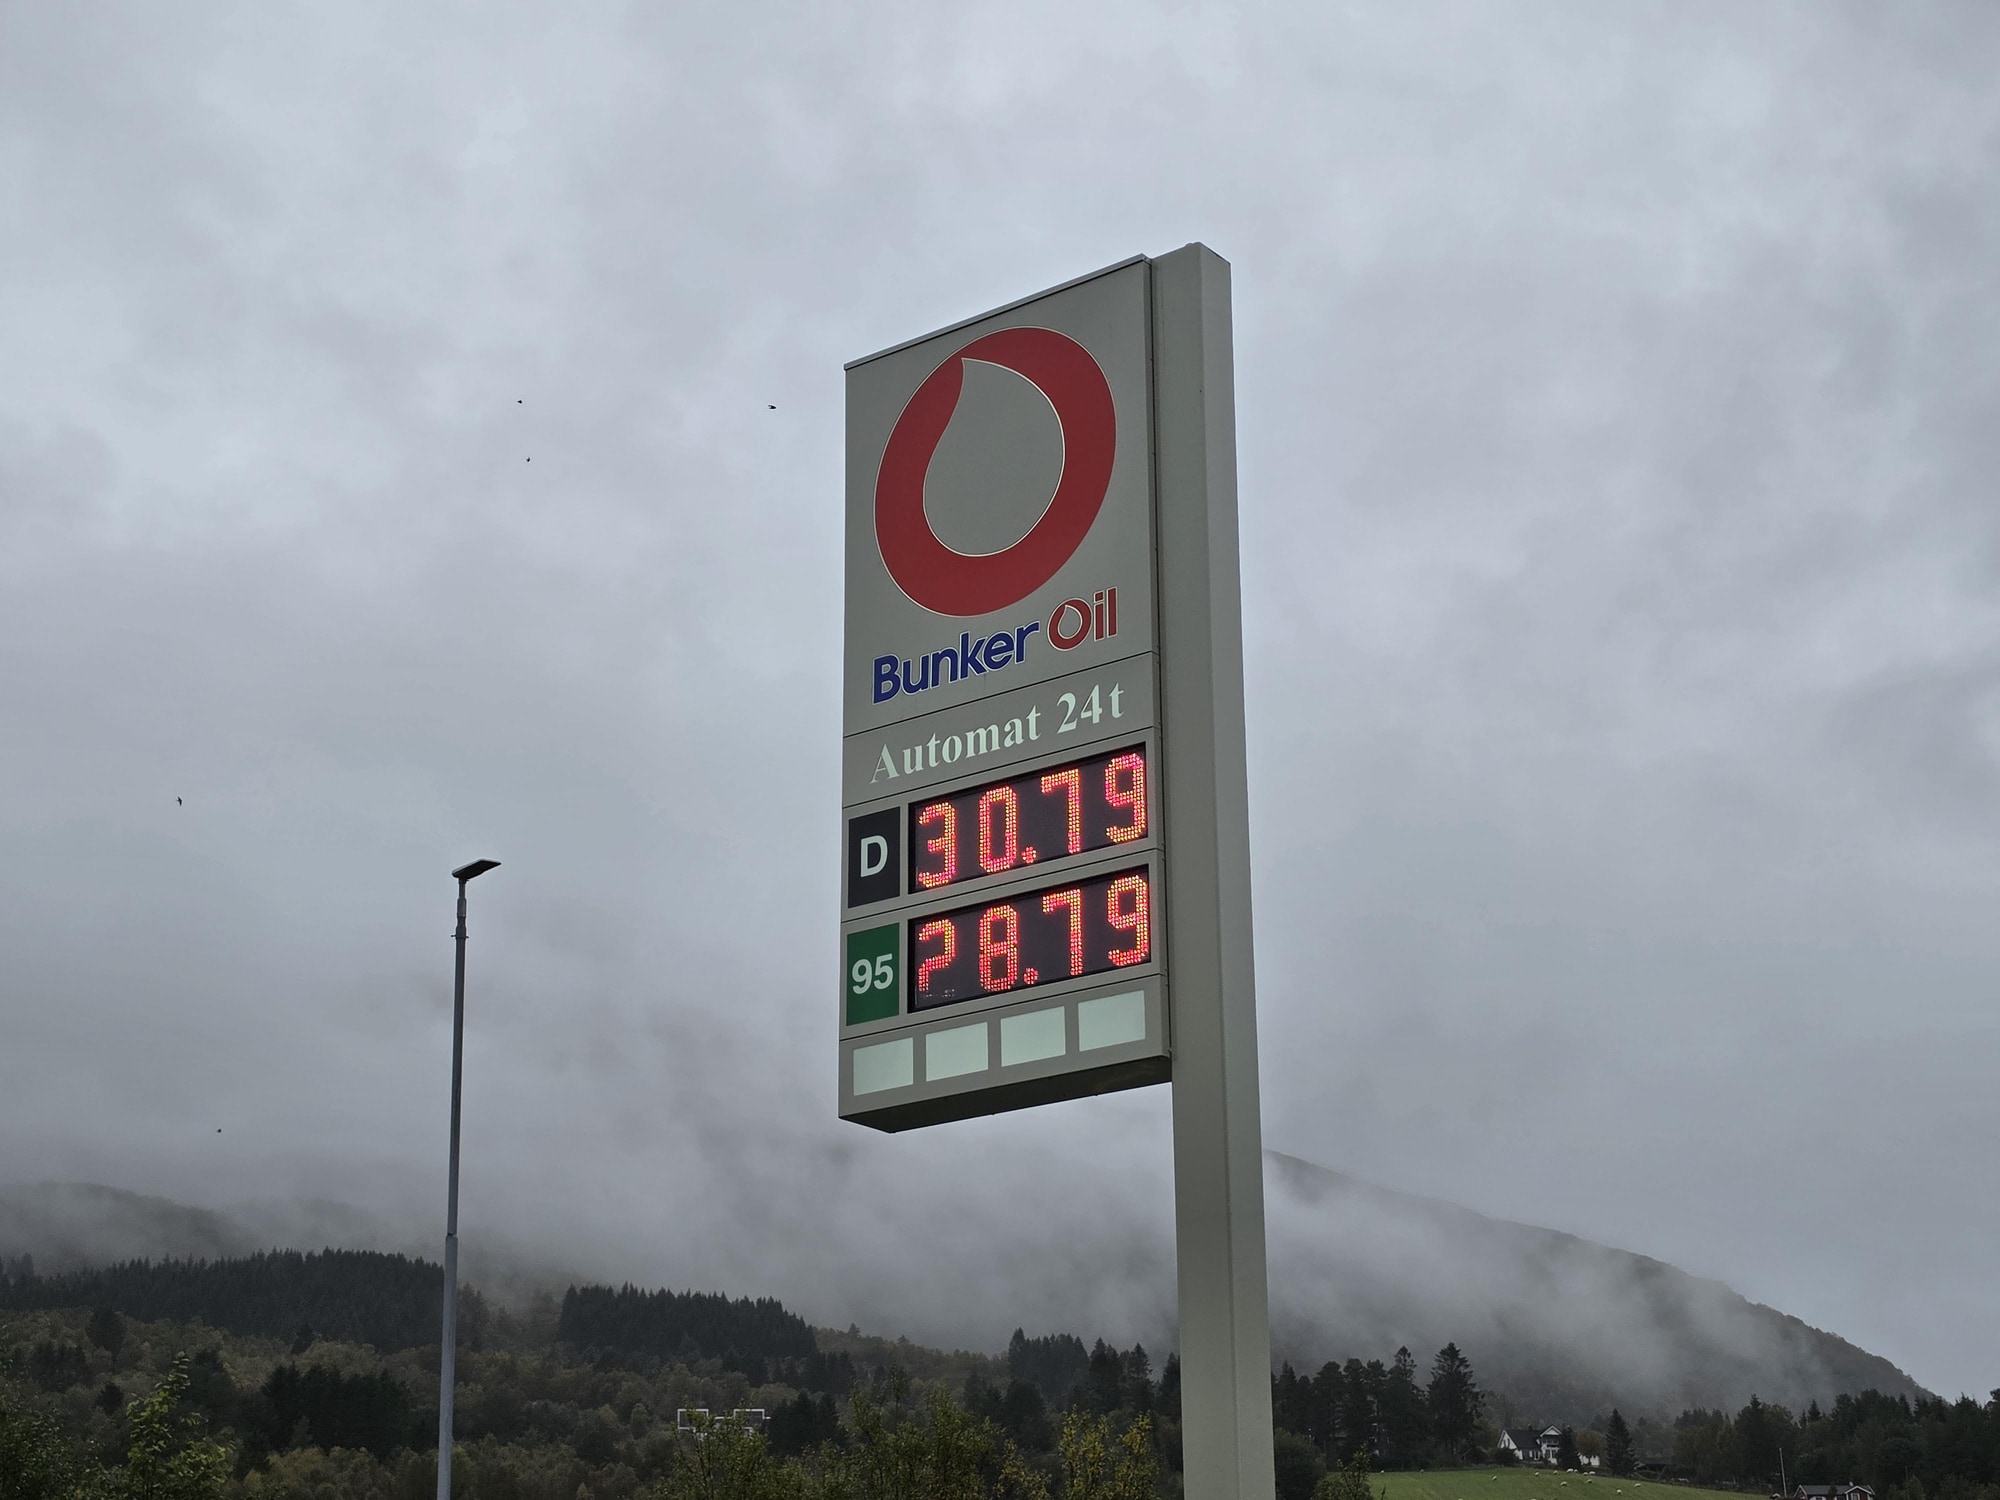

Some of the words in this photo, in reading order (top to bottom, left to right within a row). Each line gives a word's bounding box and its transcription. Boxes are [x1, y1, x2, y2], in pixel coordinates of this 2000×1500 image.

[872, 620, 1040, 705] Bunker
[1047, 585, 1118, 651] Oil
[869, 705, 1041, 784] Automat
[1056, 682, 1125, 734] 24t
[860, 834, 888, 878] D
[917, 752, 1147, 888] 30.79
[851, 953, 894, 995] 95
[917, 874, 1150, 993] 28.79
